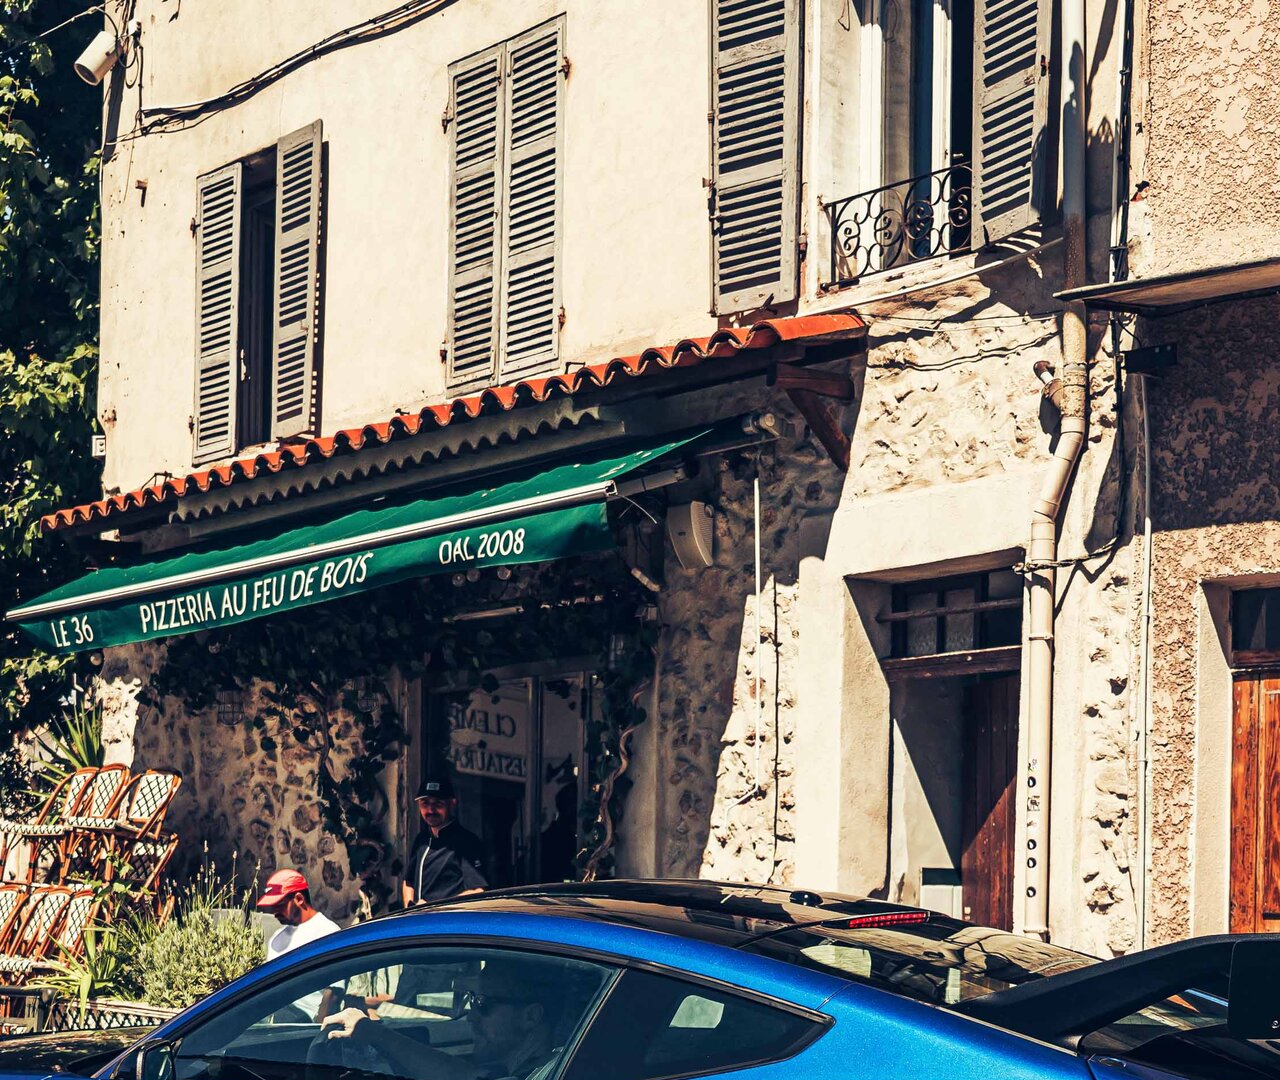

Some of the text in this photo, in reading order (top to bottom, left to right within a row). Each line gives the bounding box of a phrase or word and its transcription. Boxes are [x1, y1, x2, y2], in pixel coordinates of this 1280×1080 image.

[51, 621, 71, 649] LE
[74, 615, 94, 645] 36
[139, 595, 217, 634] PIZZERIA
[220, 583, 247, 619] AU
[252, 573, 285, 612] FEU
[290, 565, 320, 601] DE
[320, 552, 374, 593] BOIS
[477, 527, 526, 559] 2008
